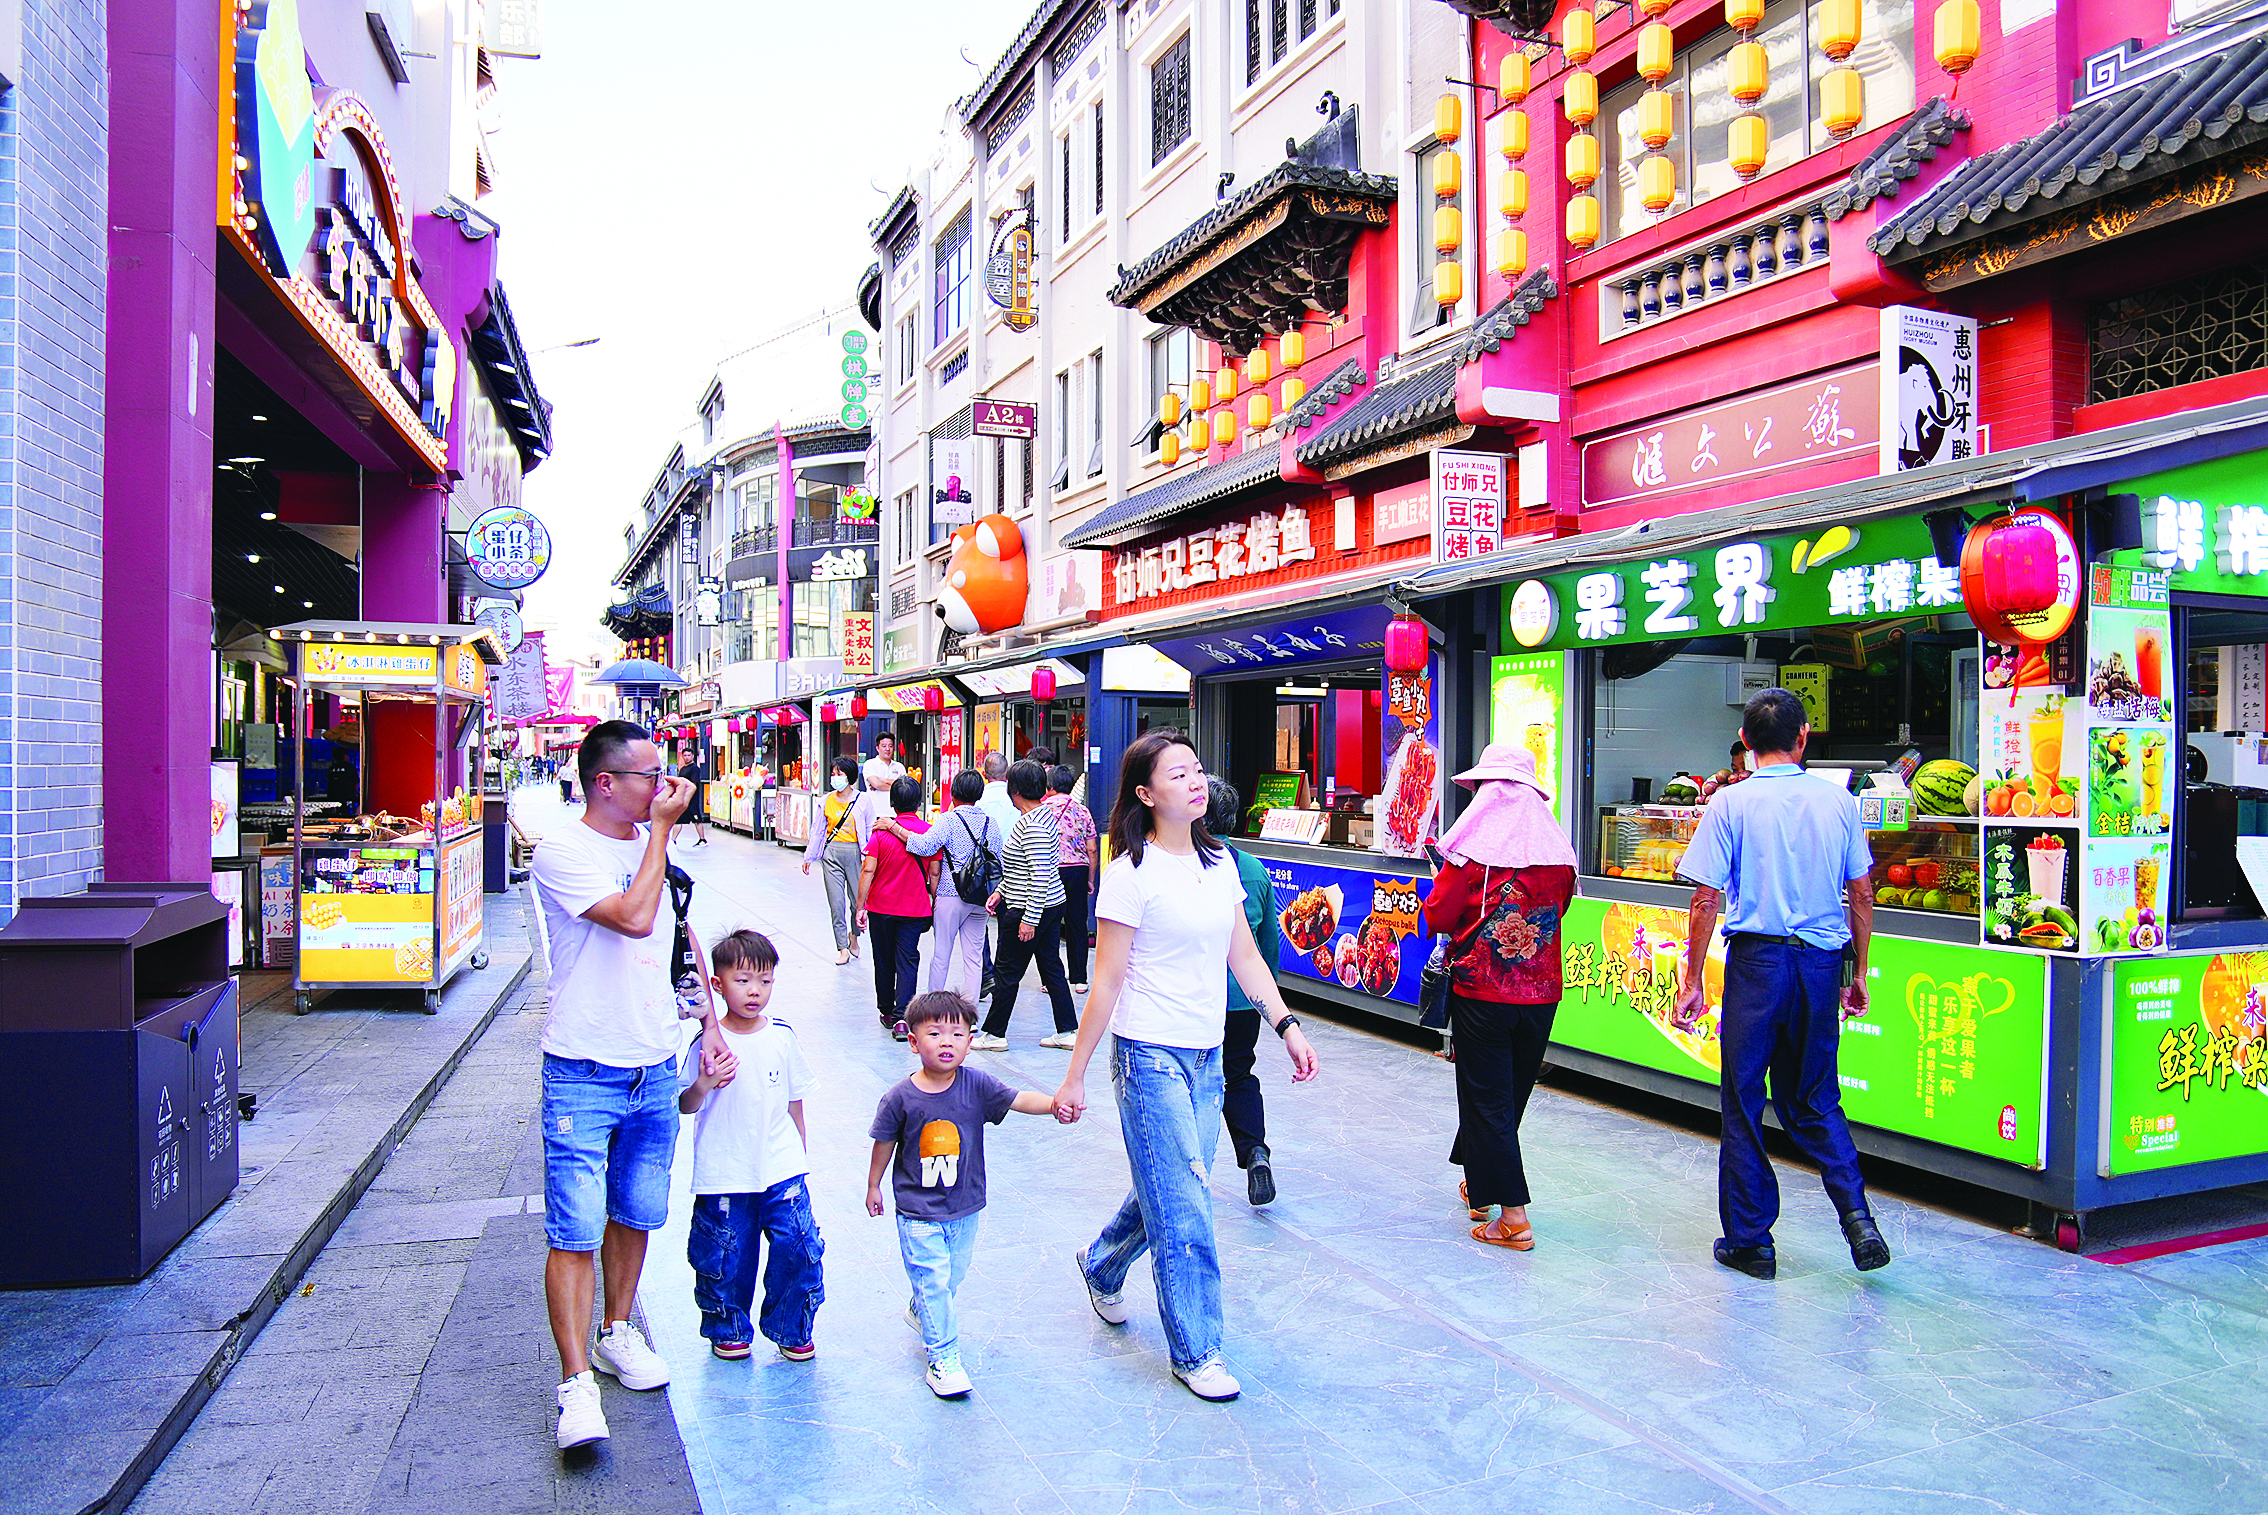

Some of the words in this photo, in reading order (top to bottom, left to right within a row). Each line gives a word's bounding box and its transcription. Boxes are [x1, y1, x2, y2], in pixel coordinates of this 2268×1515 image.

[1904, 328, 1934, 340] HUIZHOU
[844, 359, 863, 425] 棋牌室
[1471, 464, 1497, 472] XIONG
[1442, 472, 1498, 493] 付师兄
[1446, 501, 1495, 527] 豆花
[491, 530, 522, 544] 蛋仔
[491, 545, 524, 559] 小茶
[482, 564, 534, 576] 香港味道
[1575, 542, 1777, 640] 果艺界
[845, 619, 855, 666] 重庆老火锅
[856, 619, 873, 666] 文叔公
[502, 656, 532, 716] 水东茶楼
[2096, 697, 2163, 719] 海盐话梅
[2004, 719, 2021, 771] 鲜橙汁
[2095, 811, 2162, 836] 金桔柠檬
[1994, 842, 2015, 917] 木瓜牛奶
[2092, 866, 2131, 888] 百香果
[1373, 887, 1418, 914] 章鱼小丸子
[1375, 915, 1400, 928] Octopus
[1940, 996, 1958, 1097] 乐享这一杯
[2001, 1108, 2015, 1140] 尚饮
[2130, 1114, 2175, 1135] 特别推荐
[2141, 1131, 2178, 1147] Special
